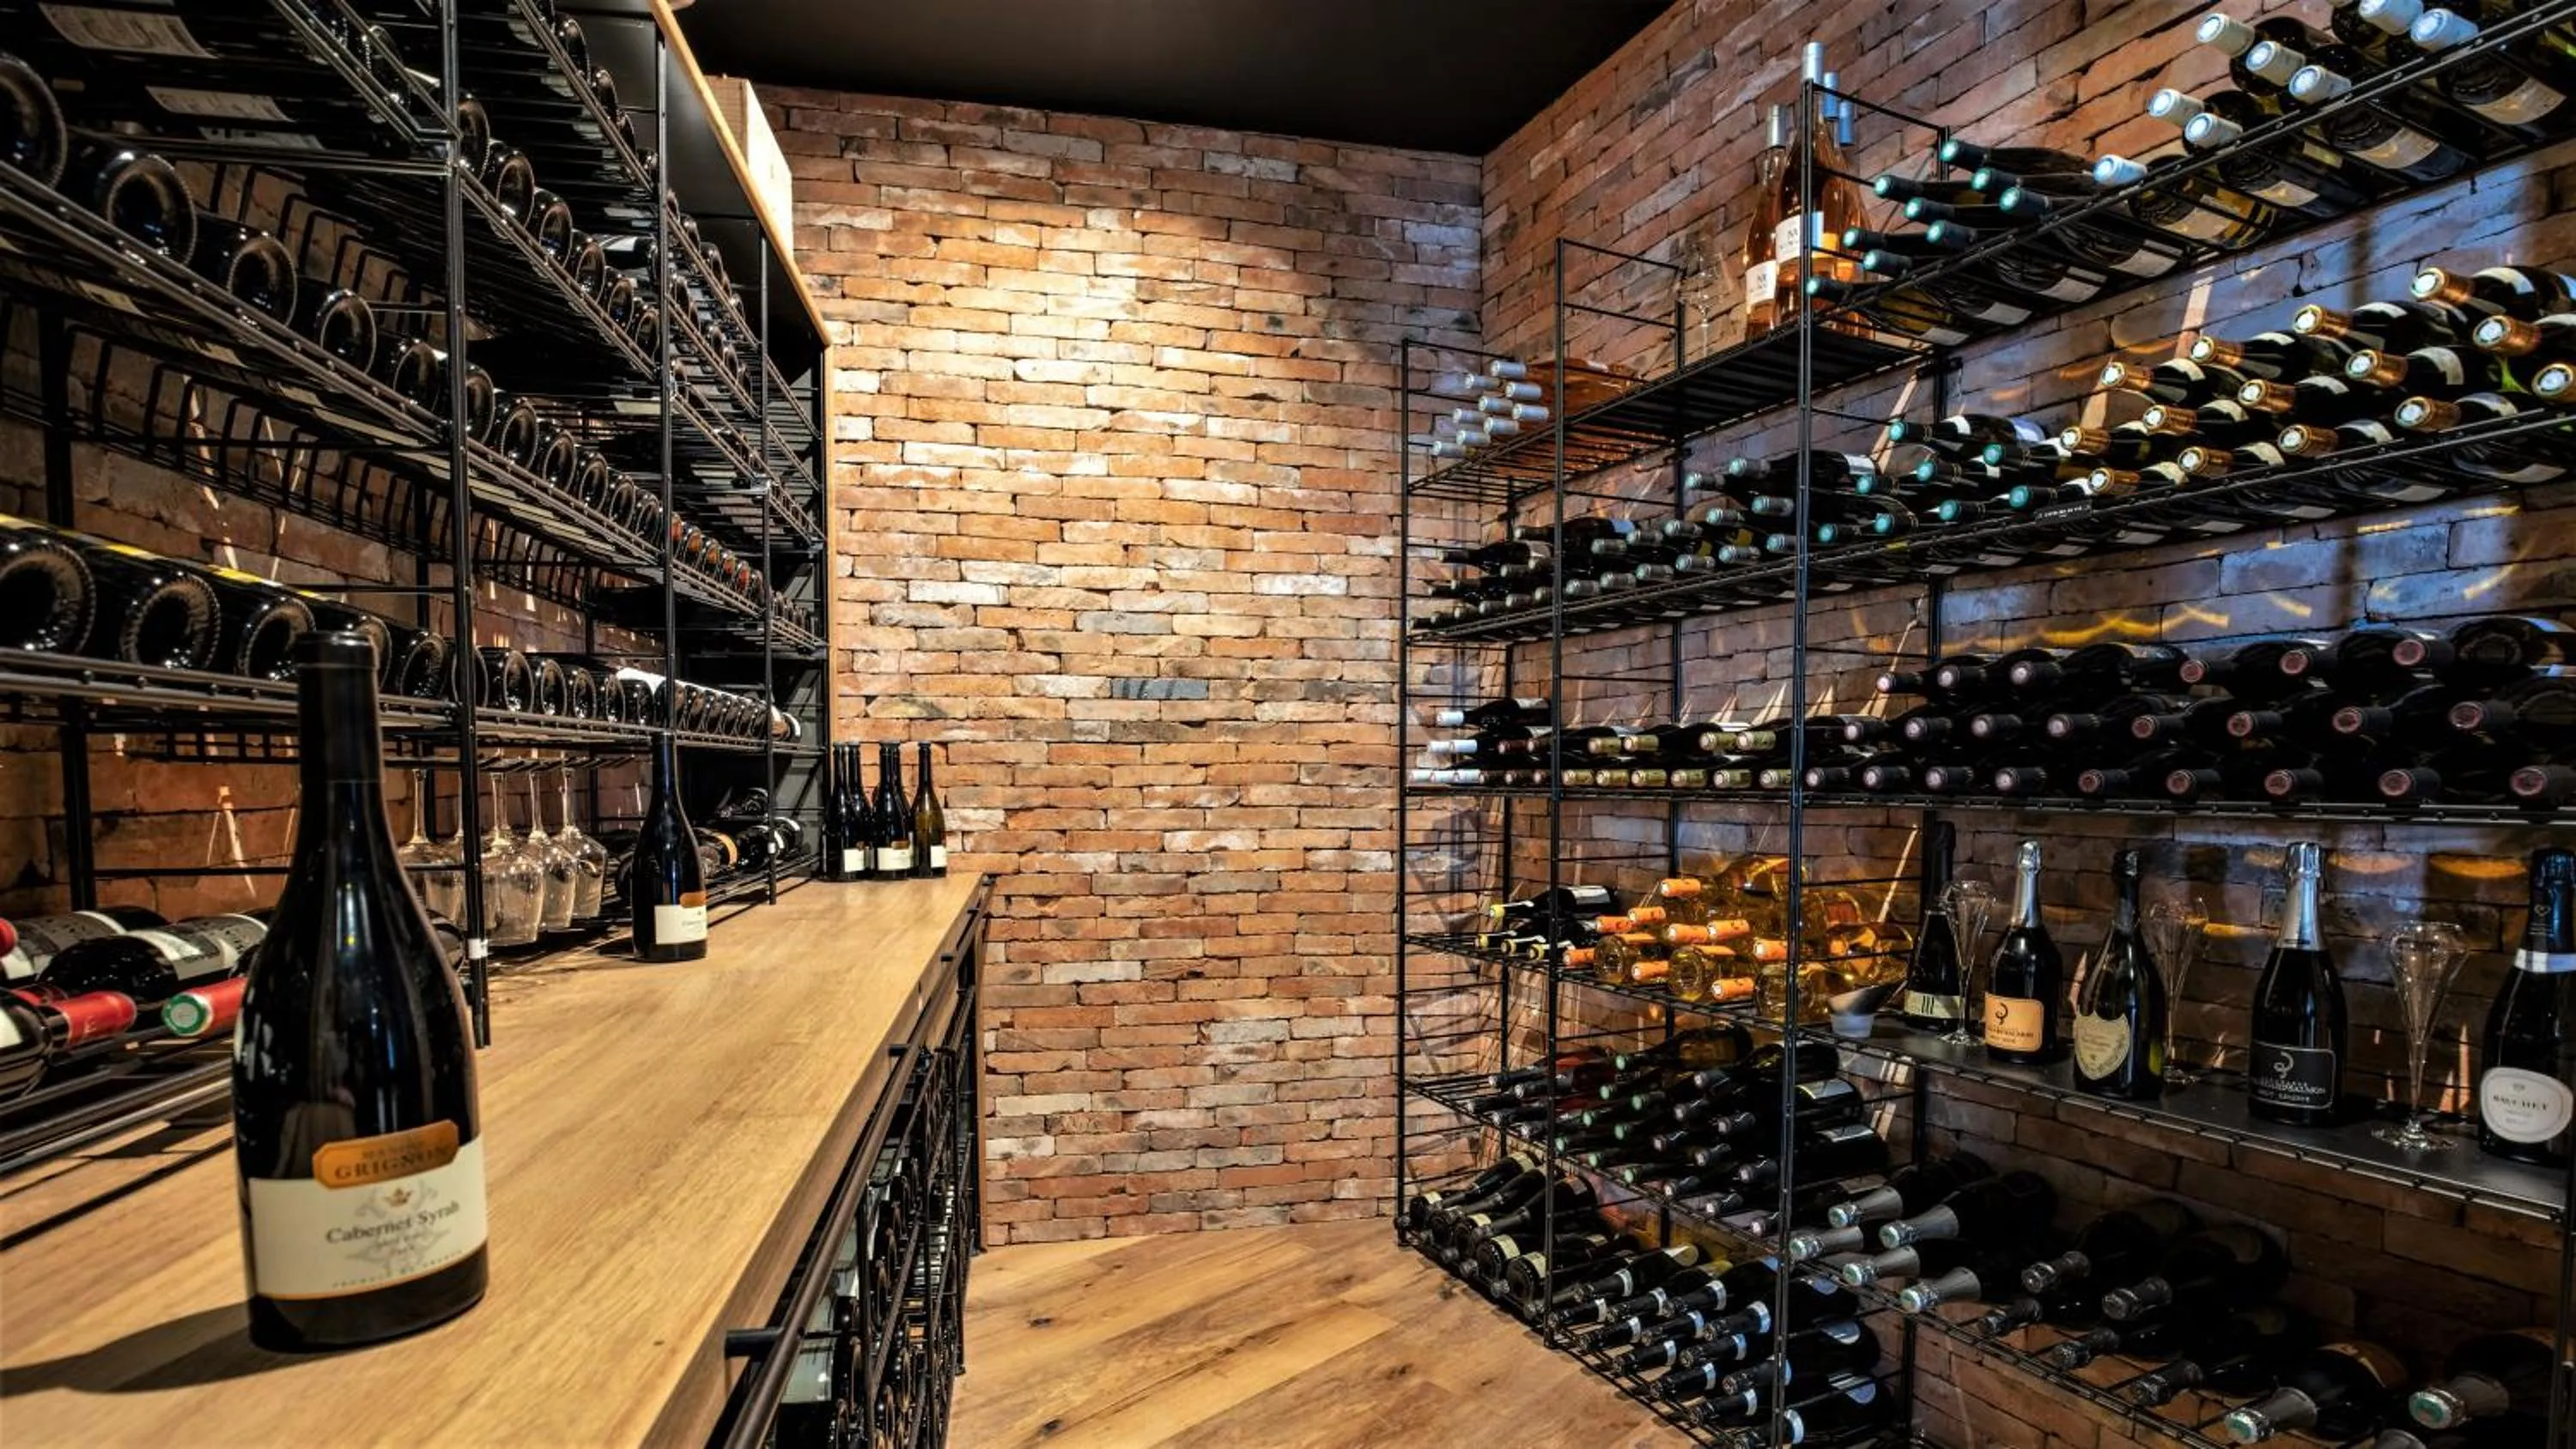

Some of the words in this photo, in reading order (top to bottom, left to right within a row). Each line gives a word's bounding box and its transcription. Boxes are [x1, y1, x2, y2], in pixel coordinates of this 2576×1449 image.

[334, 1143, 449, 1180] GRIGNON
[325, 1216, 412, 1244] Cabernet
[416, 1200, 459, 1226] Syrah
